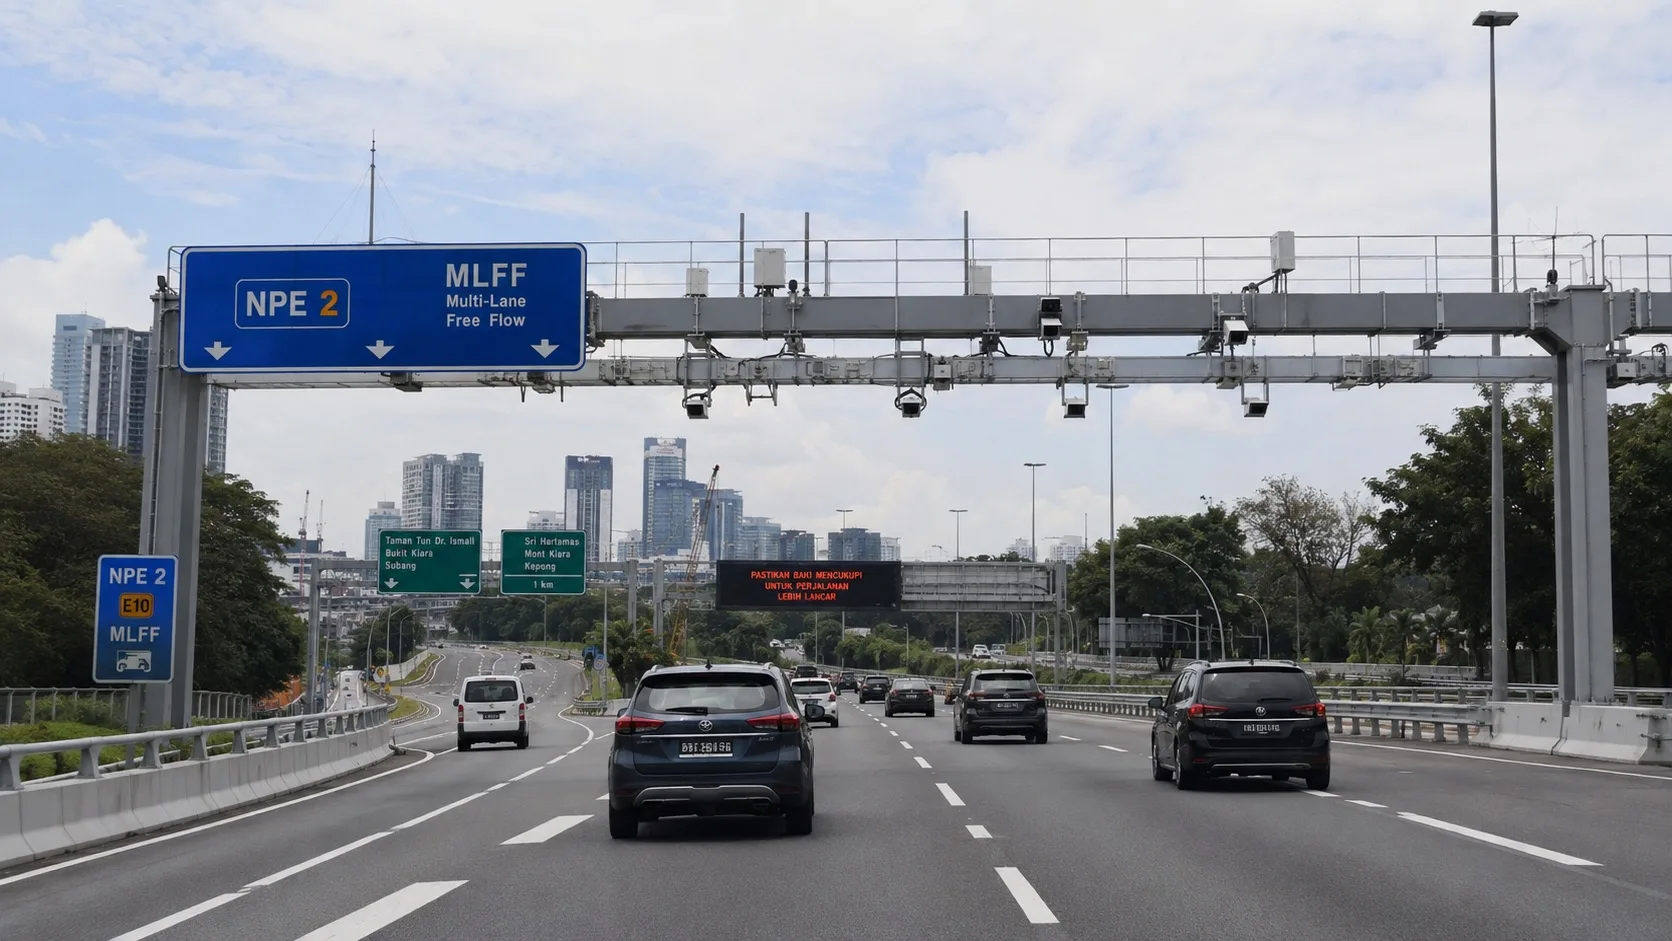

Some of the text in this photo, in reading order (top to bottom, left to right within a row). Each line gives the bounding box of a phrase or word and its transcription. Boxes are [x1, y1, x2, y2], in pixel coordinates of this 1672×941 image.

[446, 262, 528, 288] MLFF
[246, 289, 339, 317] NPE 2
[446, 293, 527, 308] Multi-Lane
[446, 313, 526, 328] Free Flow
[385, 536, 413, 545] Taman
[416, 536, 431, 545] Tun
[434, 536, 446, 545] Dr.
[524, 536, 537, 546] Sri
[524, 549, 546, 558] Mont
[385, 561, 417, 572] Subang
[524, 562, 556, 572] Kepong
[109, 567, 166, 585] NPE 2
[533, 580, 554, 589] 1 km
[764, 582, 793, 590] UNTUK
[777, 592, 802, 601] LEBIH
[122, 598, 150, 614] E10
[109, 625, 161, 643] MLFF
